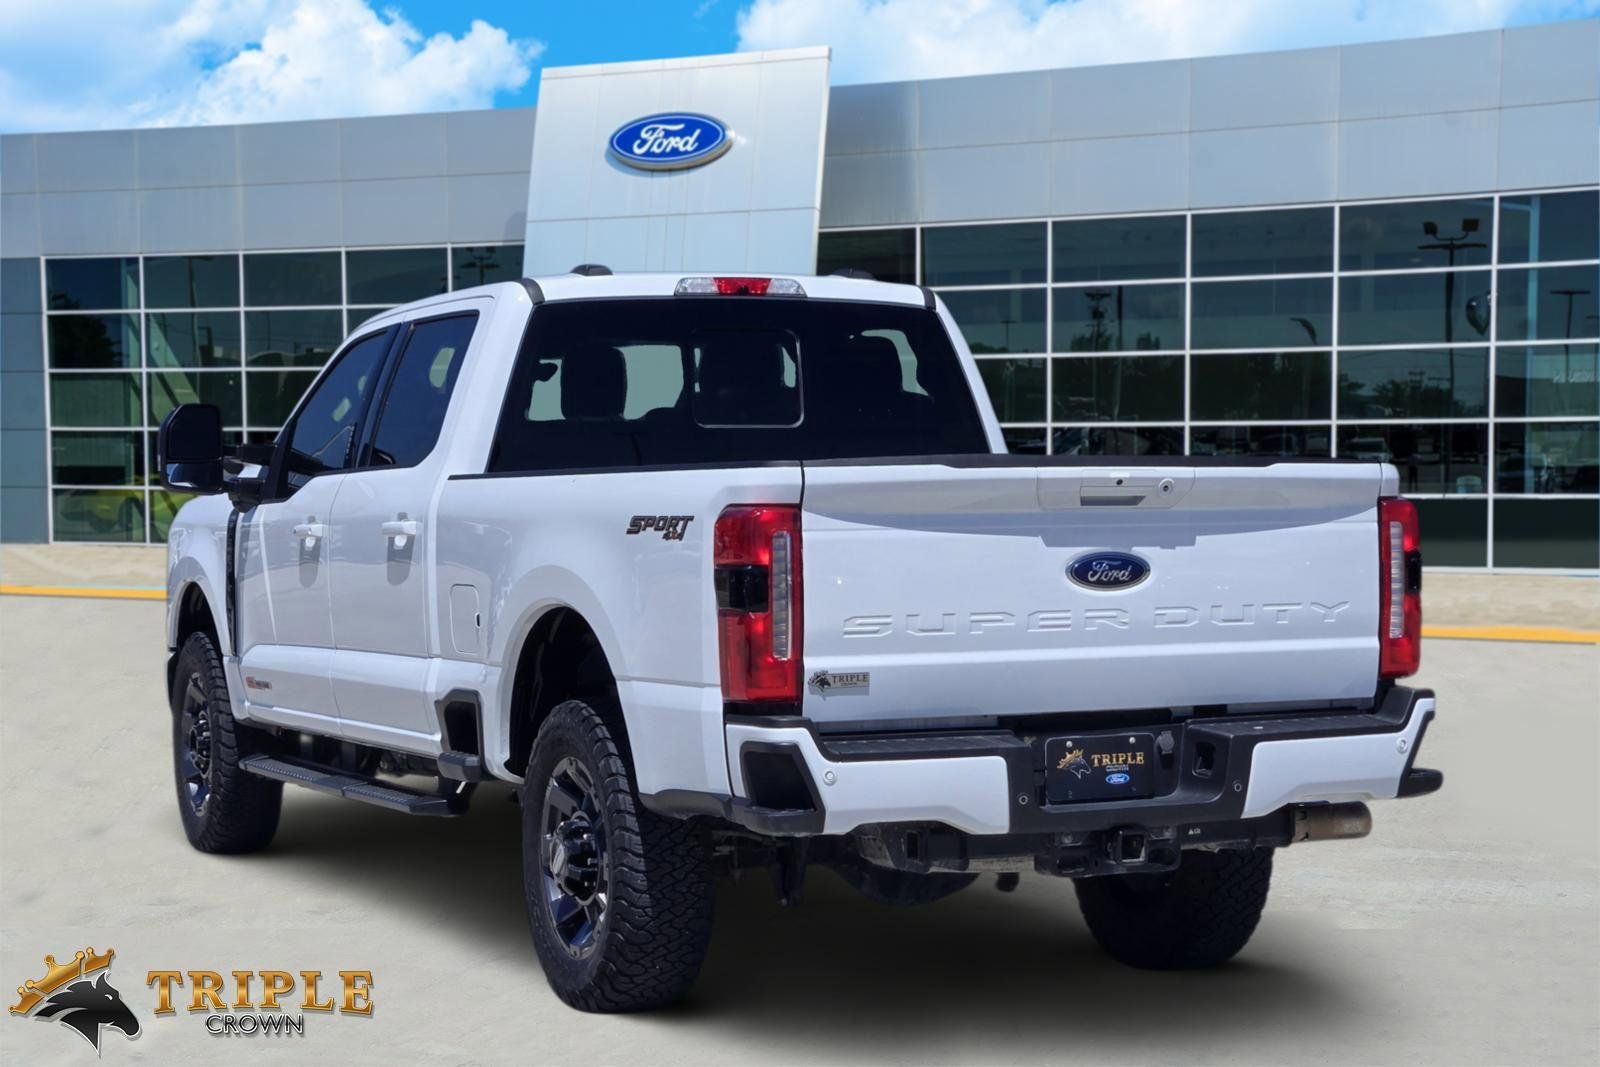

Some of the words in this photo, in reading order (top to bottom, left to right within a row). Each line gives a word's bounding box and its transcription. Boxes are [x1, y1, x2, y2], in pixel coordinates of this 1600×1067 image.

[632, 123, 701, 155] Ford
[626, 515, 695, 535] SPORT
[1087, 560, 1132, 582] Ford
[843, 607, 1129, 639] SUPER
[1154, 600, 1350, 629] DUTY
[832, 674, 867, 684] TRIPLE
[1091, 752, 1145, 767] TRIPLE
